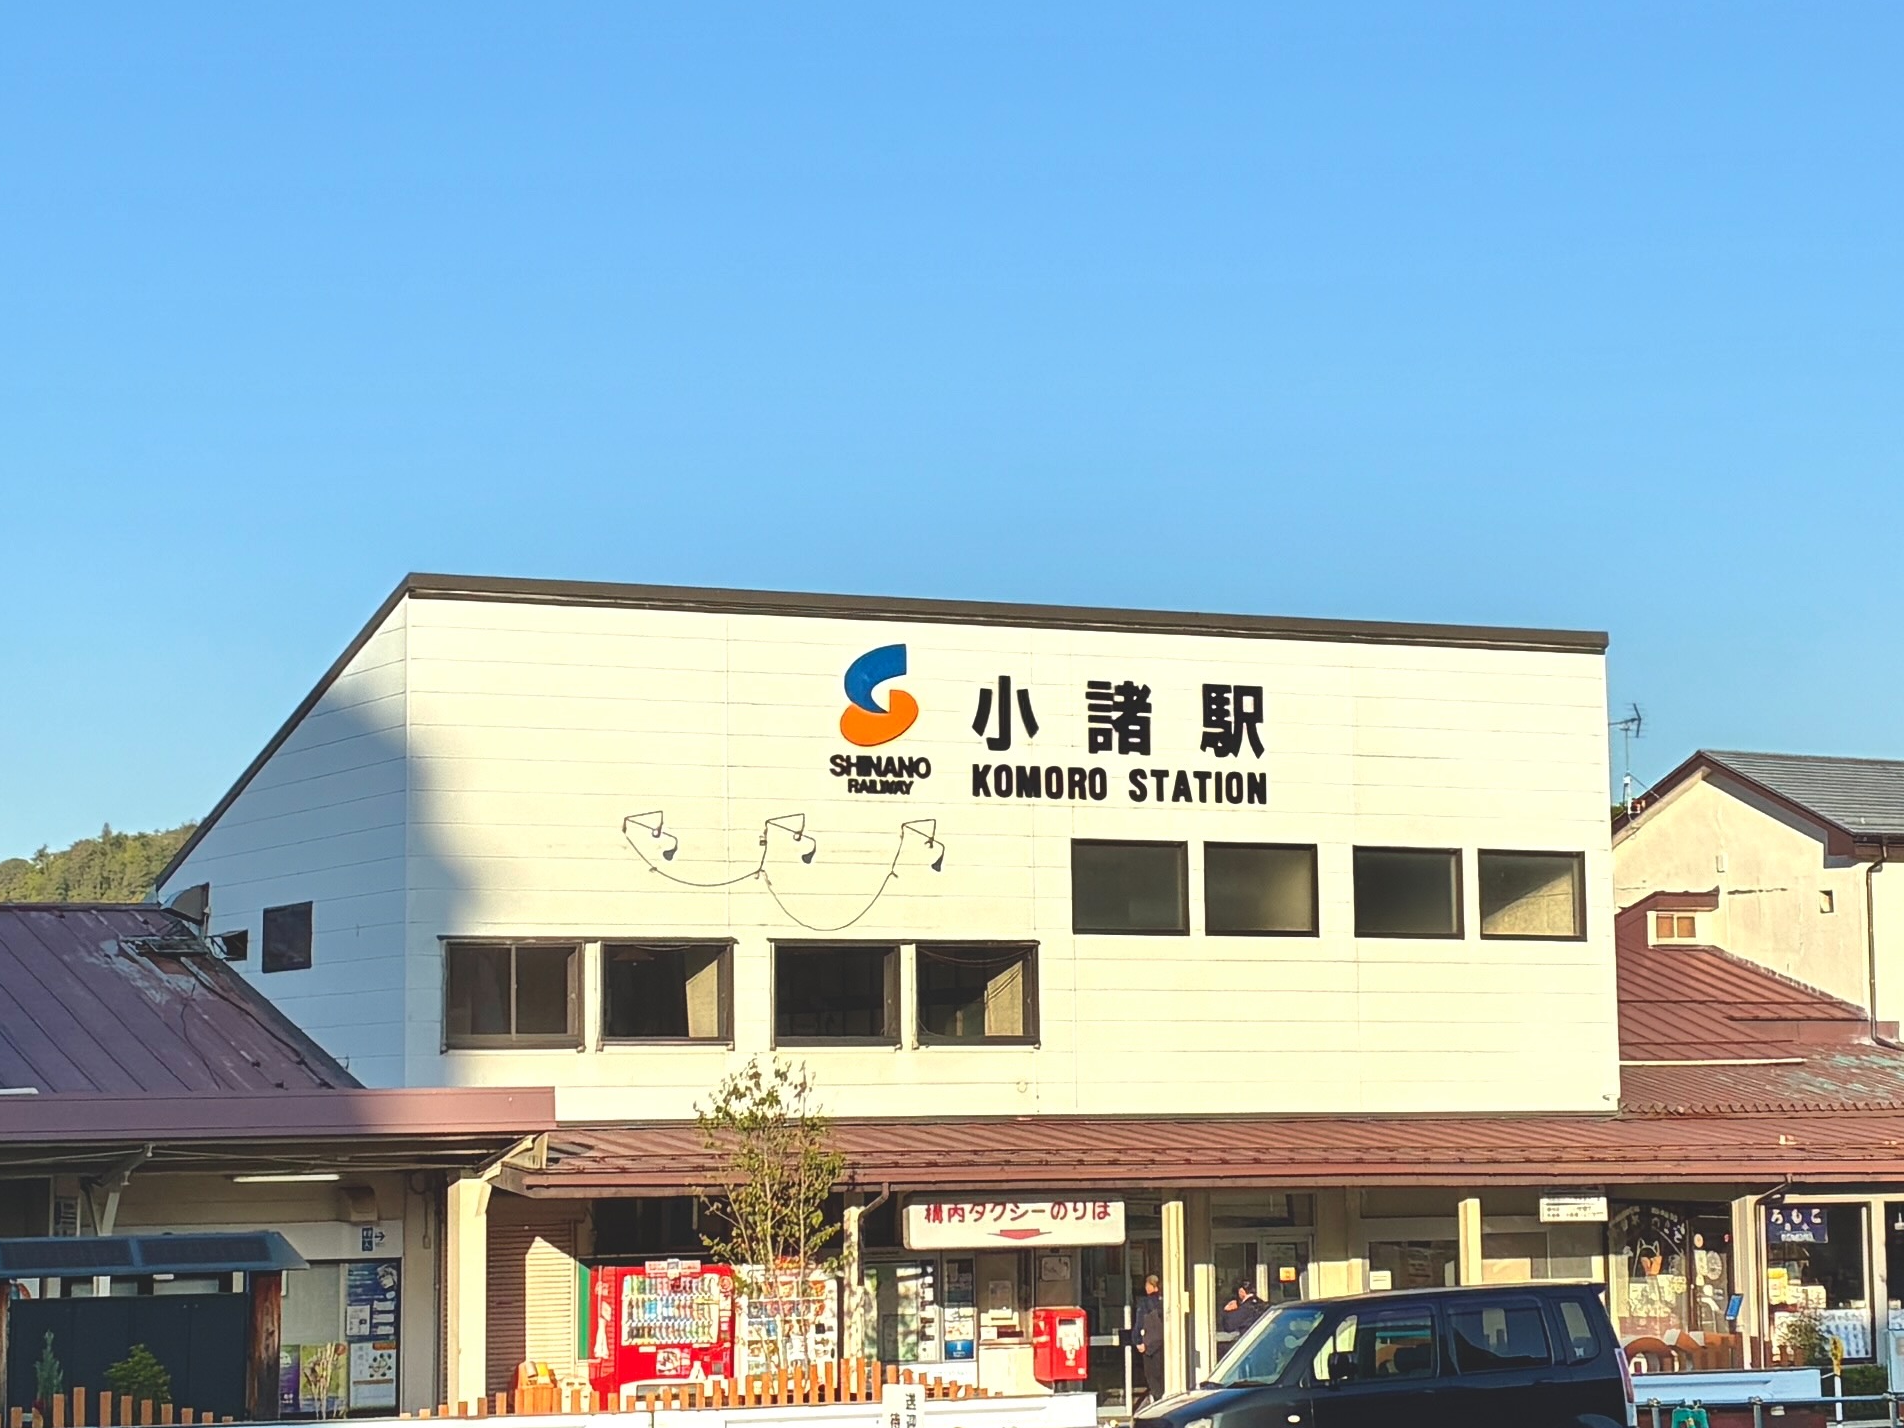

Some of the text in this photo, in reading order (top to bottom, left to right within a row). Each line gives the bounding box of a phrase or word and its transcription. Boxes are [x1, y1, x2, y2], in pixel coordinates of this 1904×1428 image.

[971, 674, 1266, 760] 小諸駅
[829, 753, 932, 780] SHINANO
[847, 778, 914, 795] RAILWAY
[972, 763, 1268, 805] KOMORO STATION
